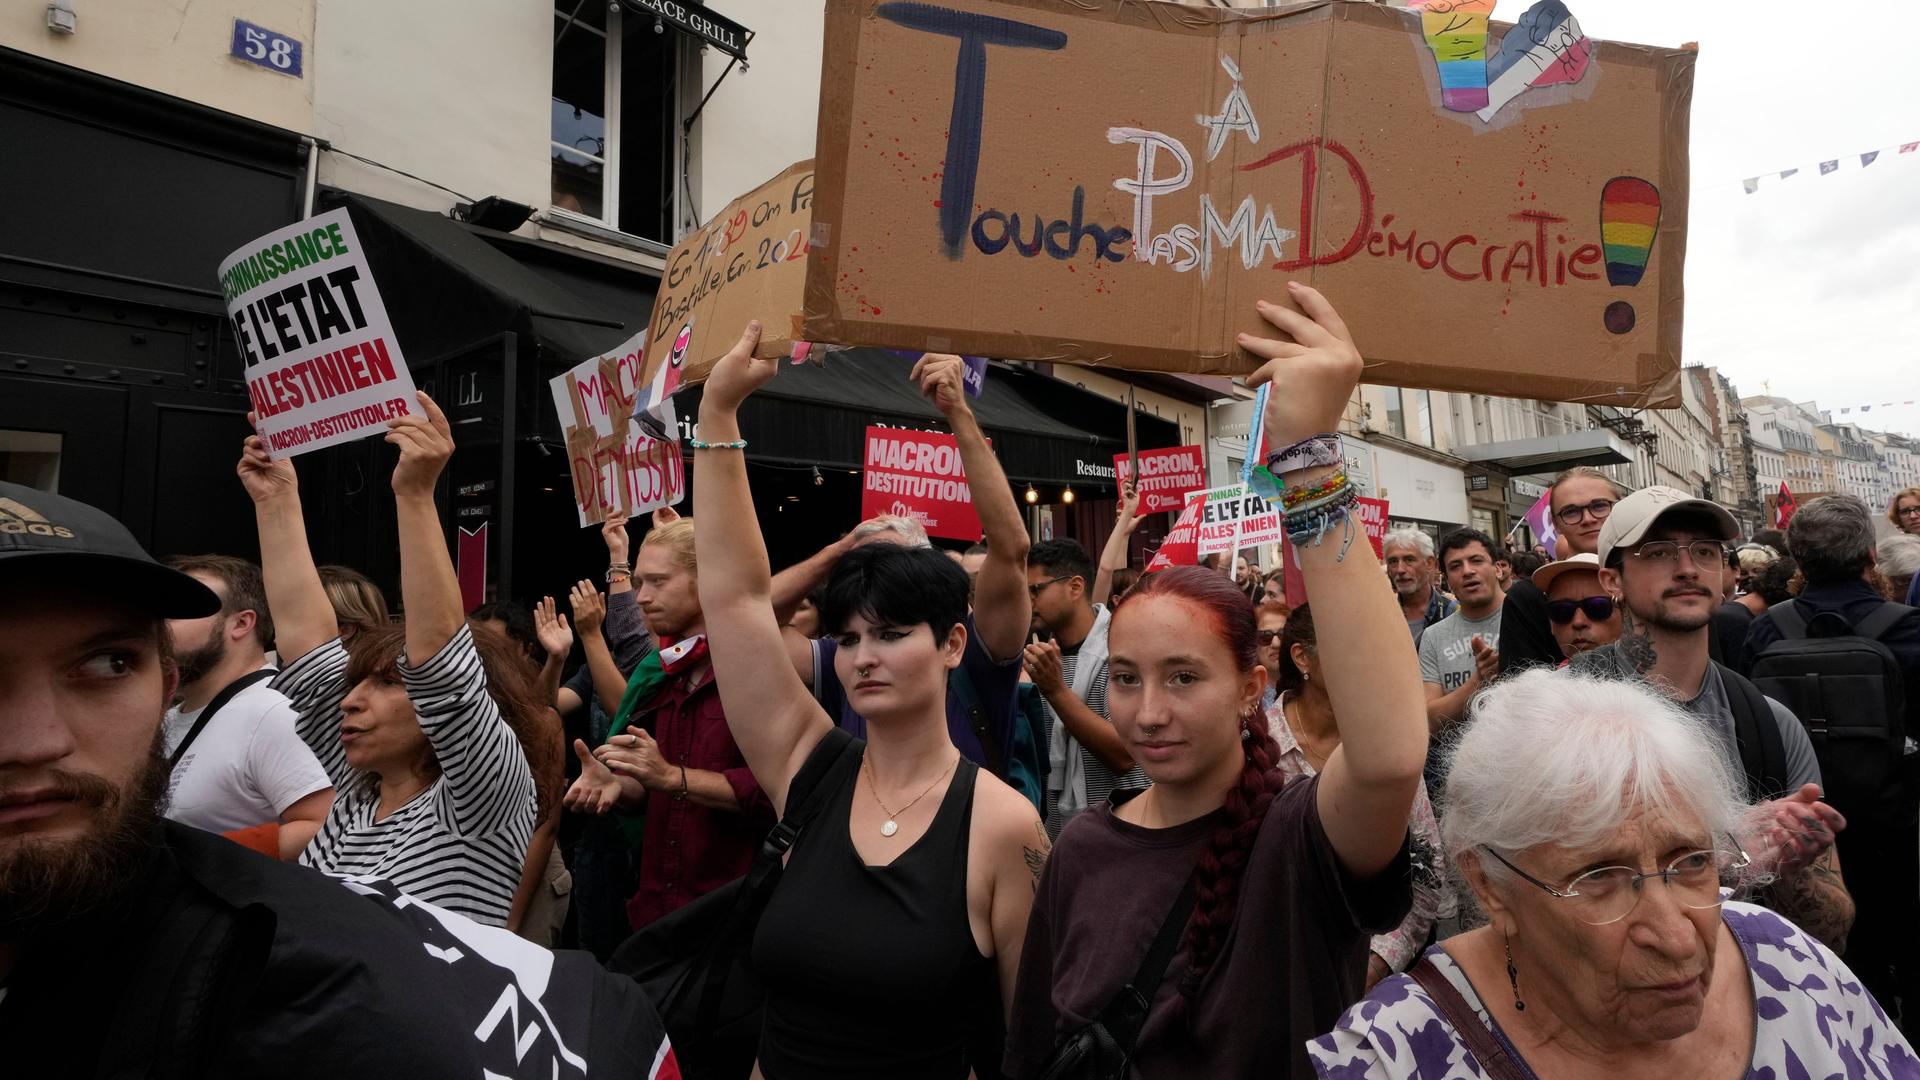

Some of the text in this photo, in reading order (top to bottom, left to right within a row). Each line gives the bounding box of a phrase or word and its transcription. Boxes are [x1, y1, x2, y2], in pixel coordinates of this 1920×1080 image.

[245, 27, 292, 69] 58
[690, 14, 739, 49] GRILL
[757, 229, 811, 269] 202
[1200, 194, 1297, 281] MA
